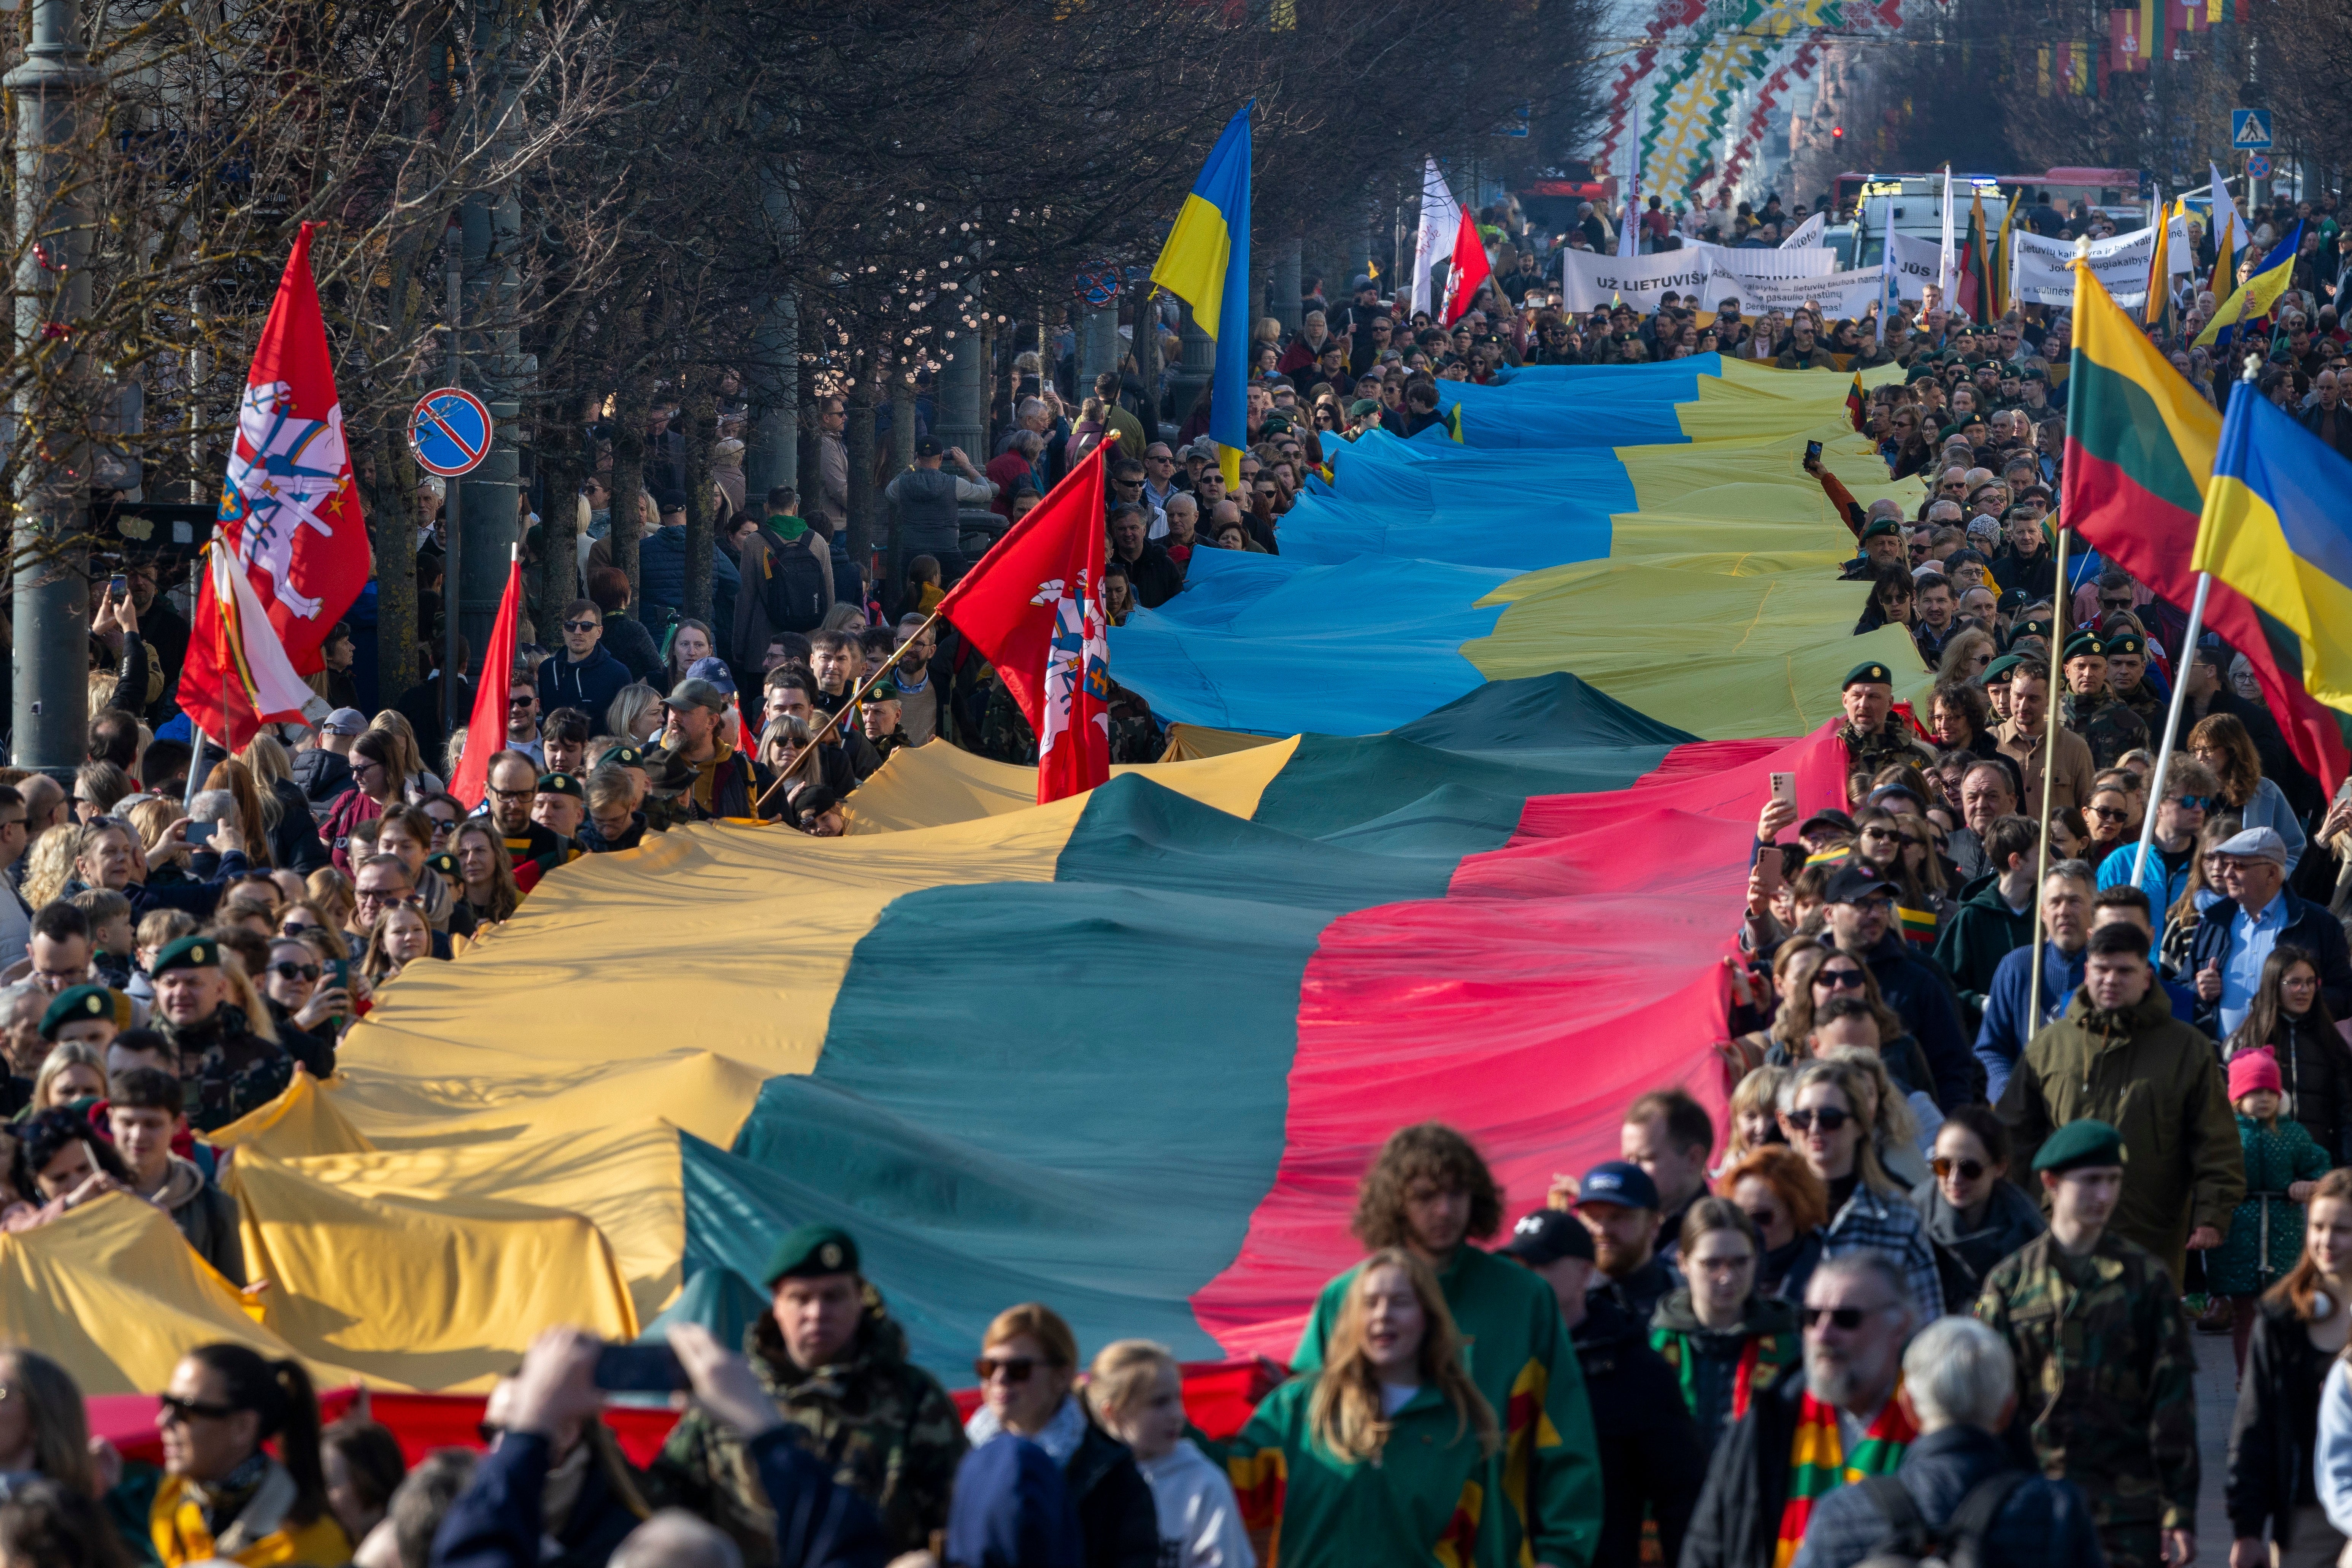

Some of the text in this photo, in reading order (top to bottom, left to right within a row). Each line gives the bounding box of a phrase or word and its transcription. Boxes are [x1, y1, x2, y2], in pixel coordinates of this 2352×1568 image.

[2018, 243, 2055, 258] Lietuvių
[2058, 249, 2077, 258] kalb
[2114, 242, 2131, 251] bus
[2134, 236, 2151, 247] vals
[2168, 227, 2185, 238] inė.
[2088, 254, 2150, 270] augiakalbys
[1597, 270, 1708, 291] UŽ LIETUVIŠK
[1793, 283, 1826, 292] lietuvių
[1827, 278, 1855, 287] tautos
[1858, 275, 1882, 284] nama
[1766, 294, 1804, 304] pasaulio
[1746, 303, 1800, 313] pereinamas
